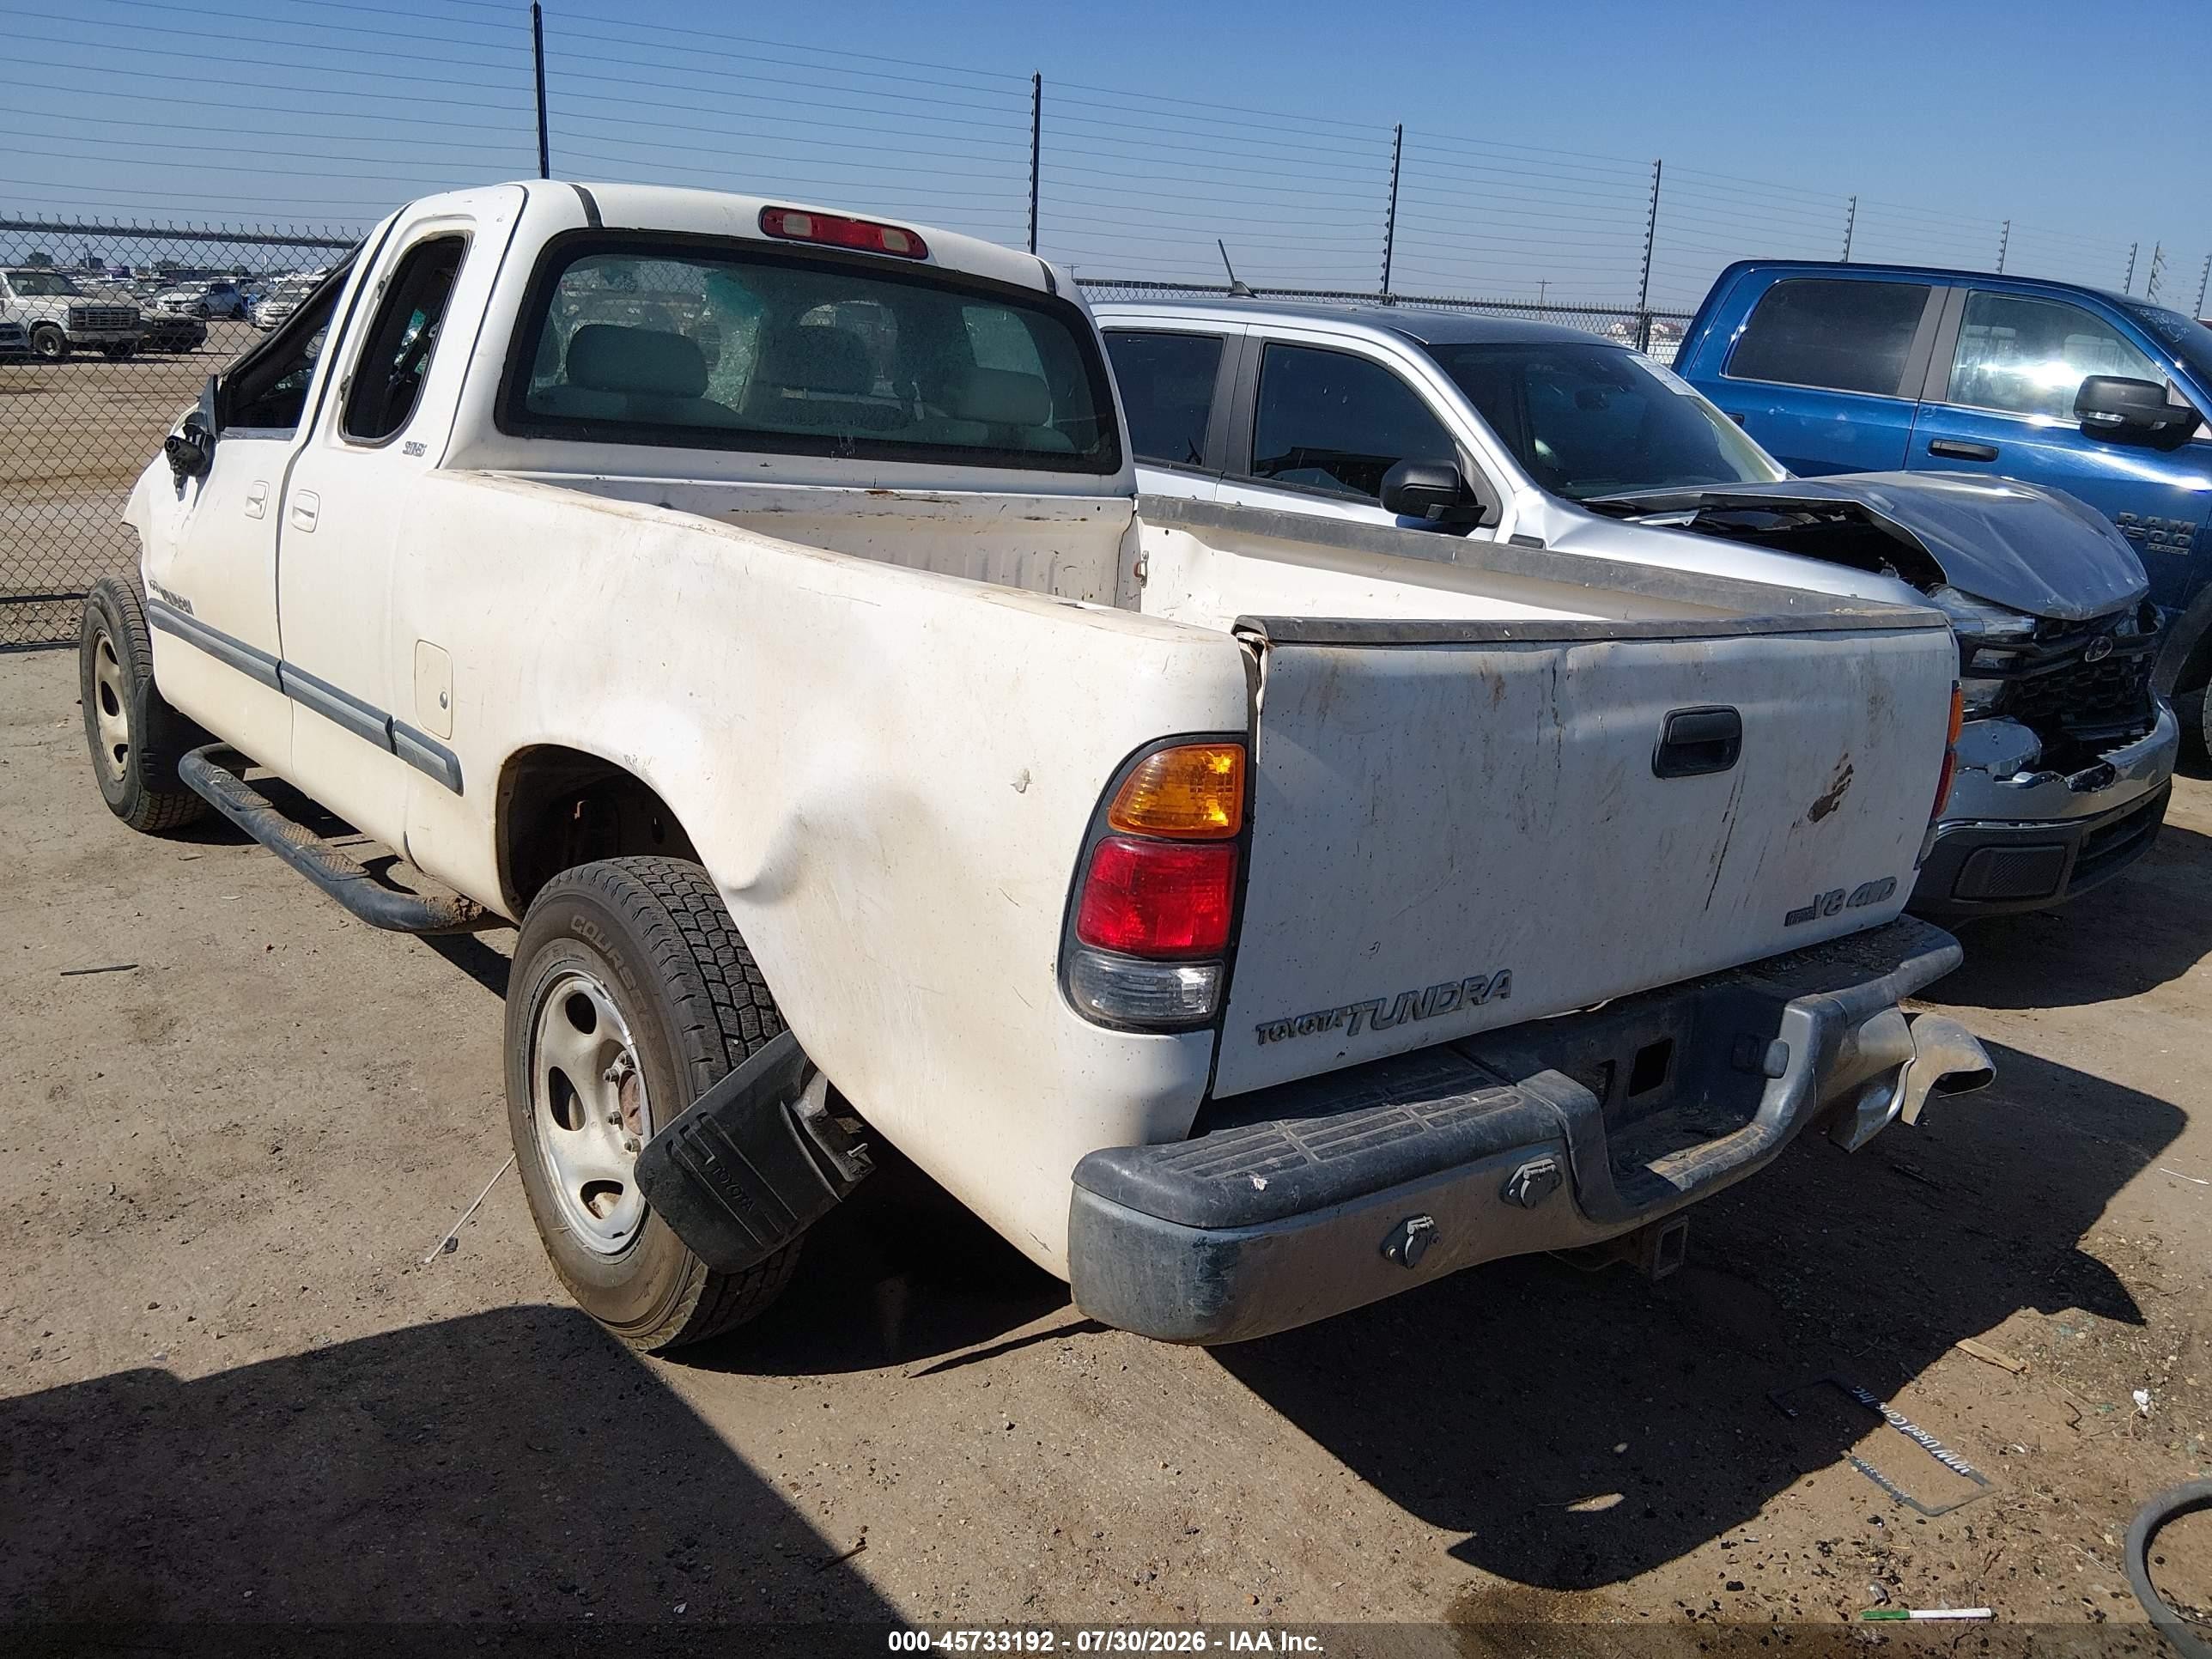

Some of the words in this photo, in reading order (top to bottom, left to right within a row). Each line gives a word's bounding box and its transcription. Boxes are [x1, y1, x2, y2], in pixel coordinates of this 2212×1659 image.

[2116, 511, 2197, 535] RAM
[1255, 1006, 1346, 1046] TOYOTA
[1346, 968, 1513, 1037] TUNDRA
[1899, 1424, 1942, 1449] Used
